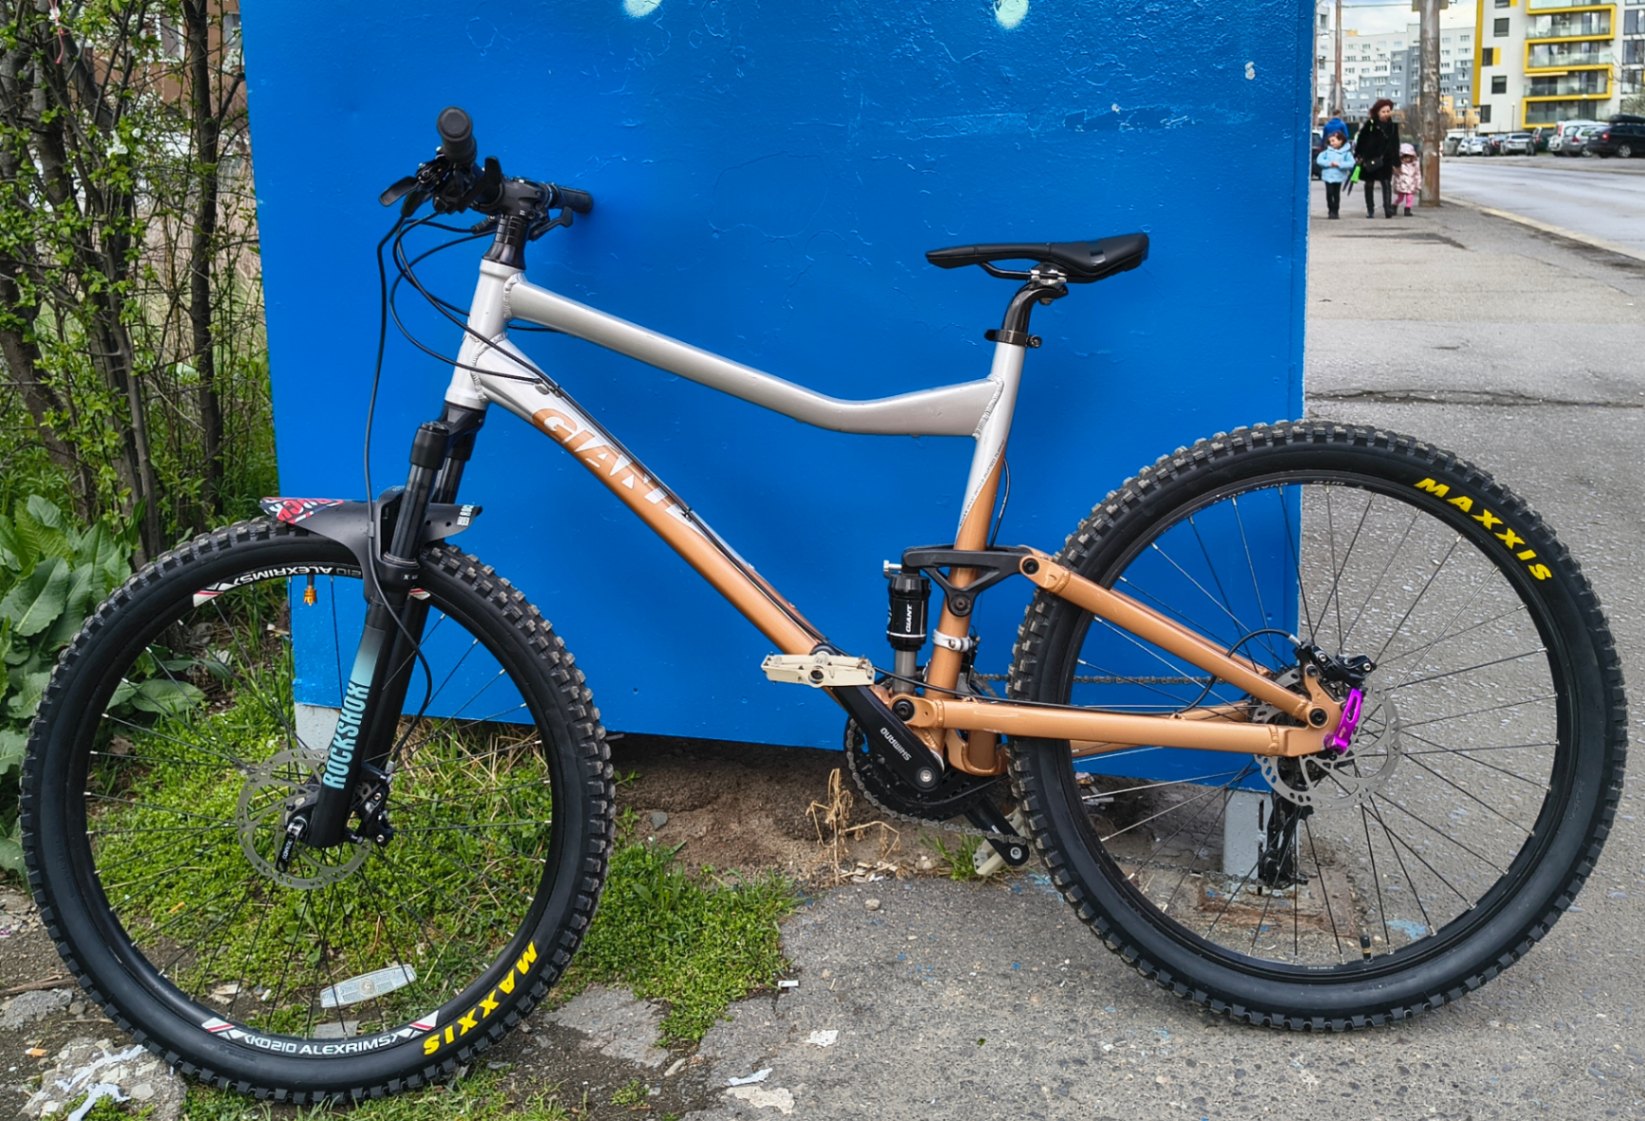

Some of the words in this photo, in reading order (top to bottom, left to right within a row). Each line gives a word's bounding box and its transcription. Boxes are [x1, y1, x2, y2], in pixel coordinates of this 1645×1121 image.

[531, 407, 678, 512] GIANT
[1413, 477, 1553, 581] MAXXIS
[240, 565, 333, 582] ALEXRIMS
[905, 603, 913, 633] GIANT
[322, 680, 371, 789] ROCKSHOX
[880, 727, 912, 761] SHIMANO
[423, 941, 538, 1056] MAXXIS
[299, 1034, 391, 1055] ALEXRIMS
